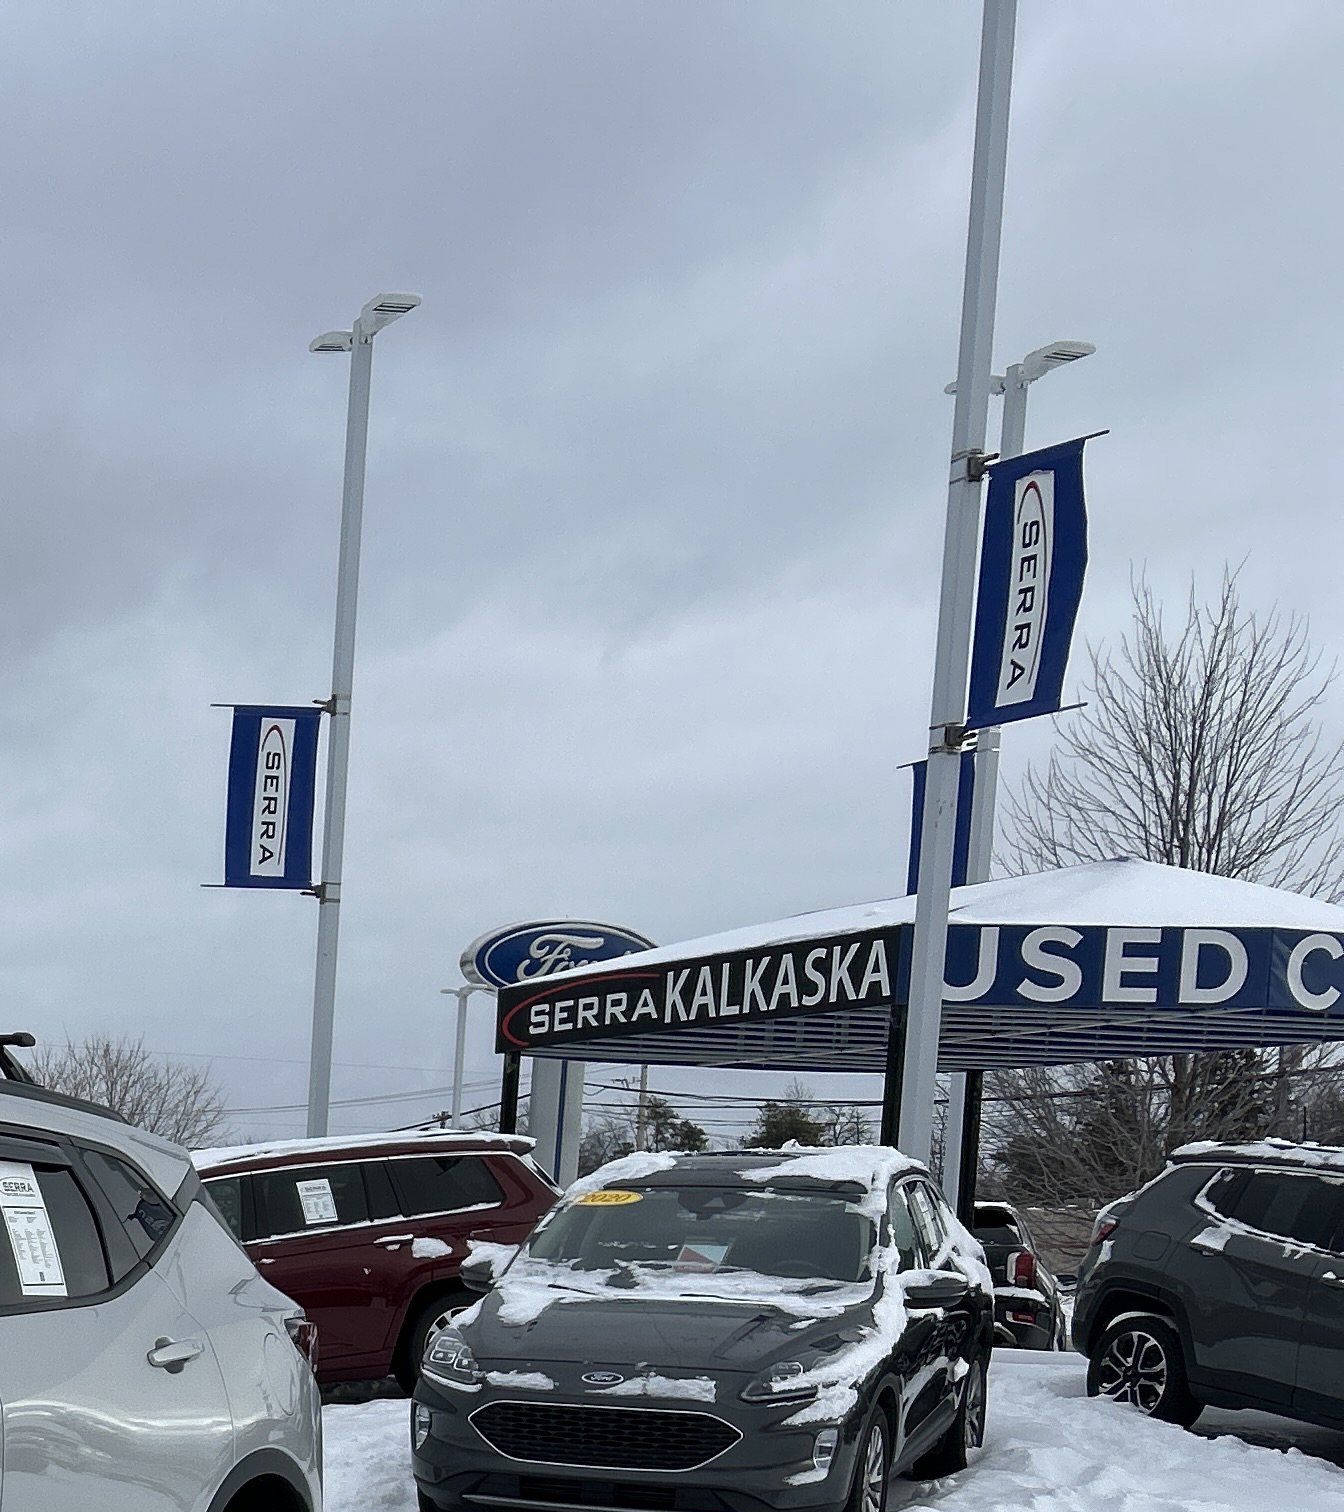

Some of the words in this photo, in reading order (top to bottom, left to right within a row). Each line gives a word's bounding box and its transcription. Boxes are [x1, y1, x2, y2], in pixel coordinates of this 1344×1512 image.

[1006, 519, 1040, 690] SERRA
[258, 751, 281, 865] SERRA
[528, 988, 658, 1035] SERRA
[663, 939, 892, 1024] KALKASKA
[942, 926, 1249, 1004] USED
[2, 1181, 34, 1193] SERRA
